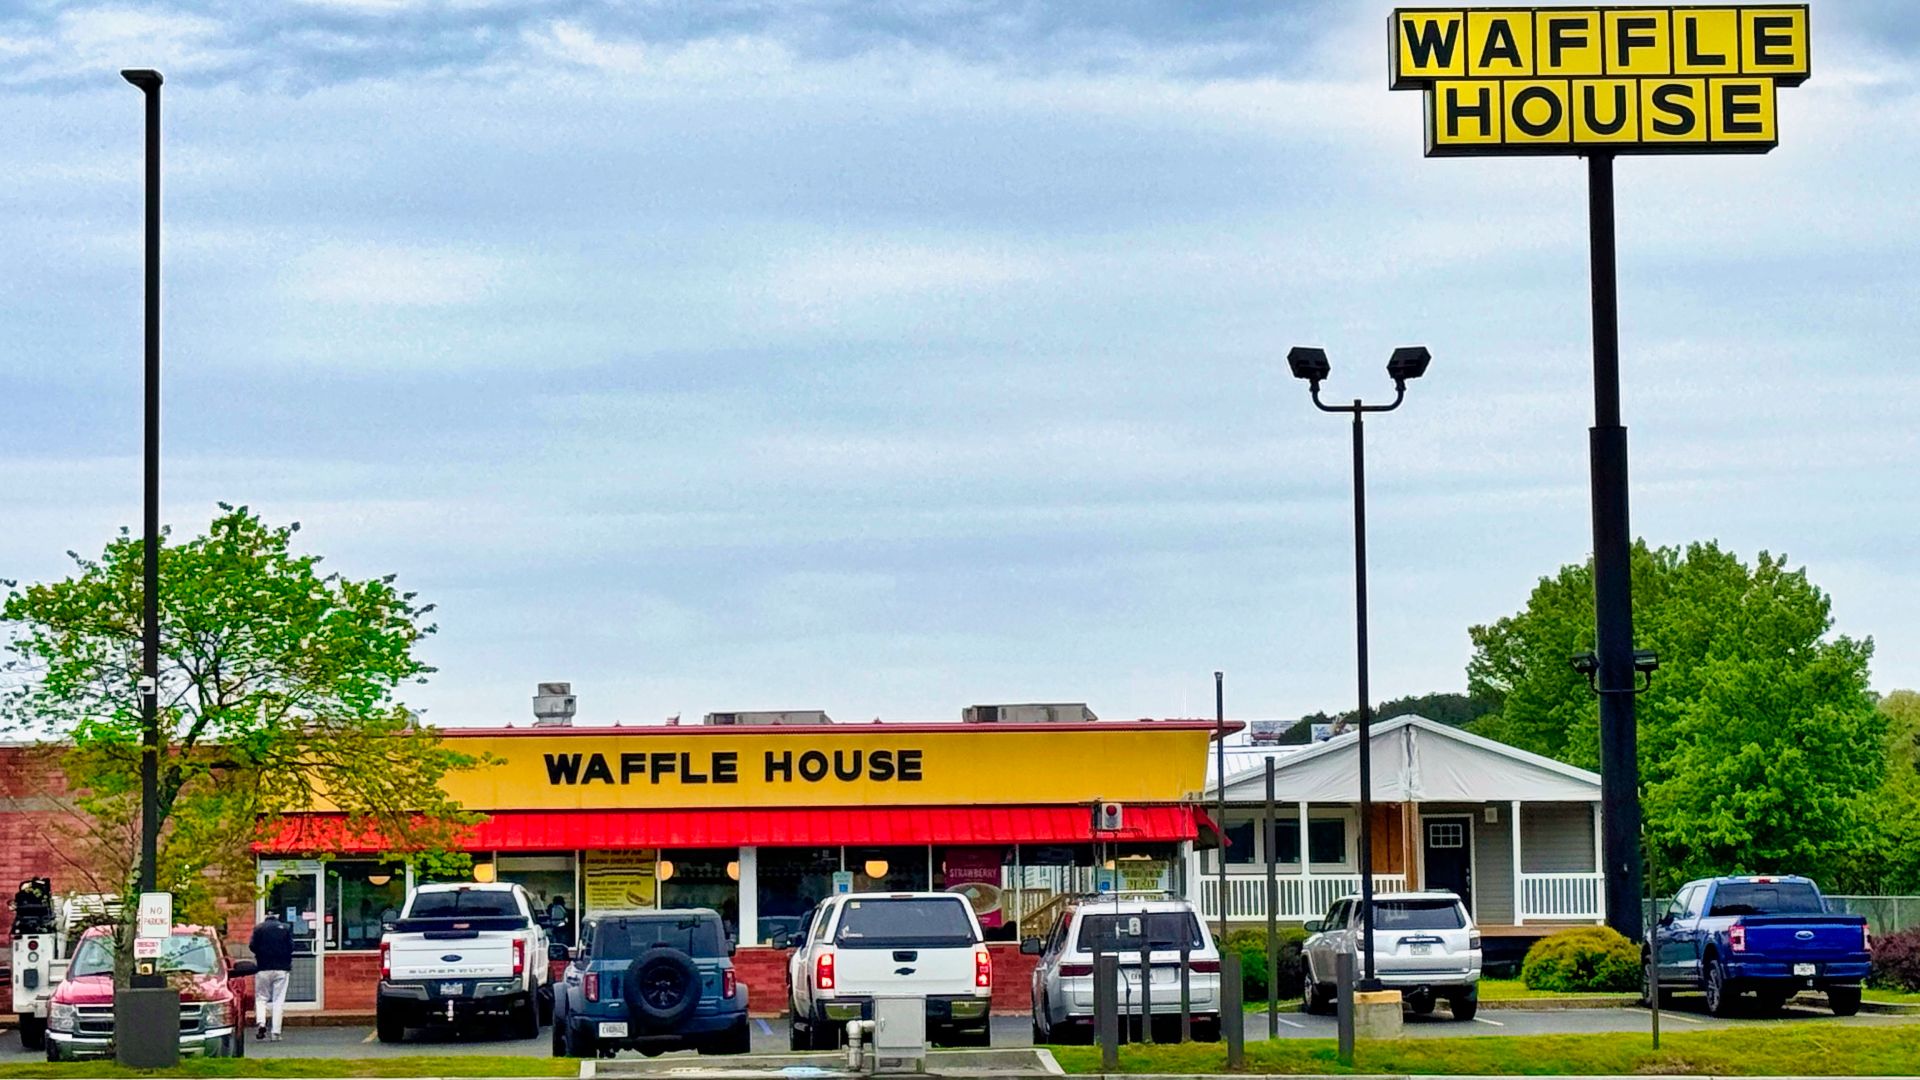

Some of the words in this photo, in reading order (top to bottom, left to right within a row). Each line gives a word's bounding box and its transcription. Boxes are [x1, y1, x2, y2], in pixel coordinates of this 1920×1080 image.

[1402, 16, 1795, 69] WAFFLE
[1446, 84, 1763, 136] HOUSE
[543, 752, 737, 785] WAFFLE
[765, 750, 923, 782] HOUSE
[949, 868, 997, 878] STRAWBERRY
